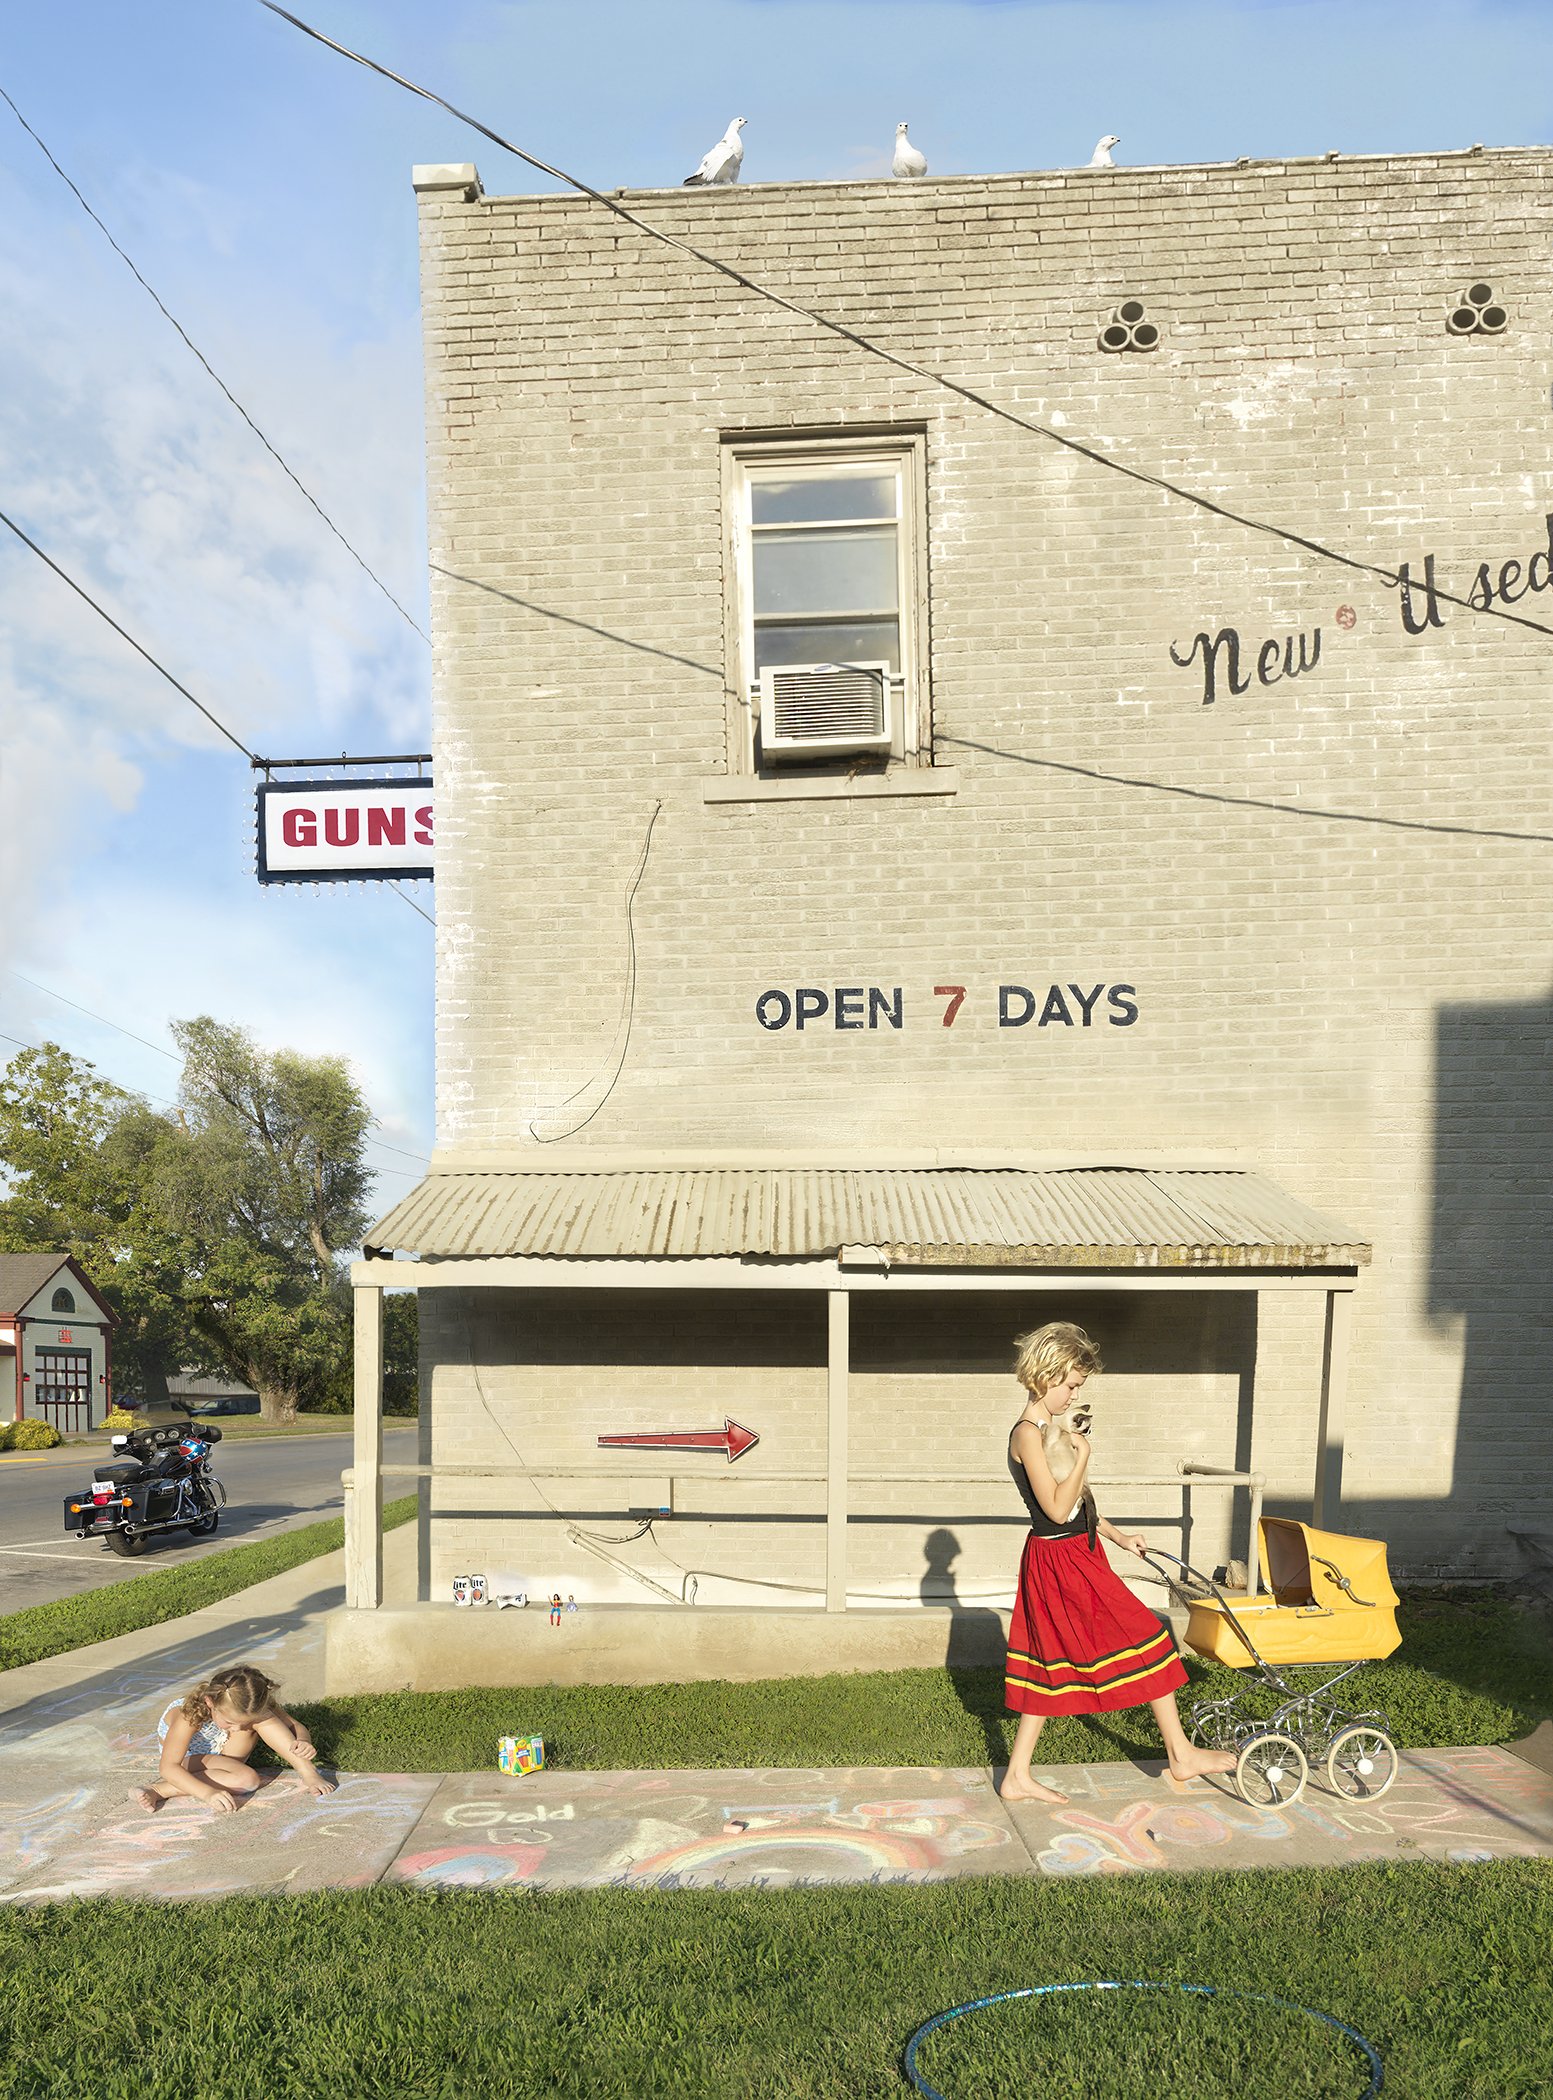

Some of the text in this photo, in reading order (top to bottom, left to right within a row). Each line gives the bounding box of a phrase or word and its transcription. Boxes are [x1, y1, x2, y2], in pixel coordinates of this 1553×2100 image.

[1169, 513, 1553, 705] New Used
[755, 984, 1140, 1031] OPEN 7 DAYS
[453, 1581, 467, 1590] Lite
[443, 1801, 575, 1828] Gold
